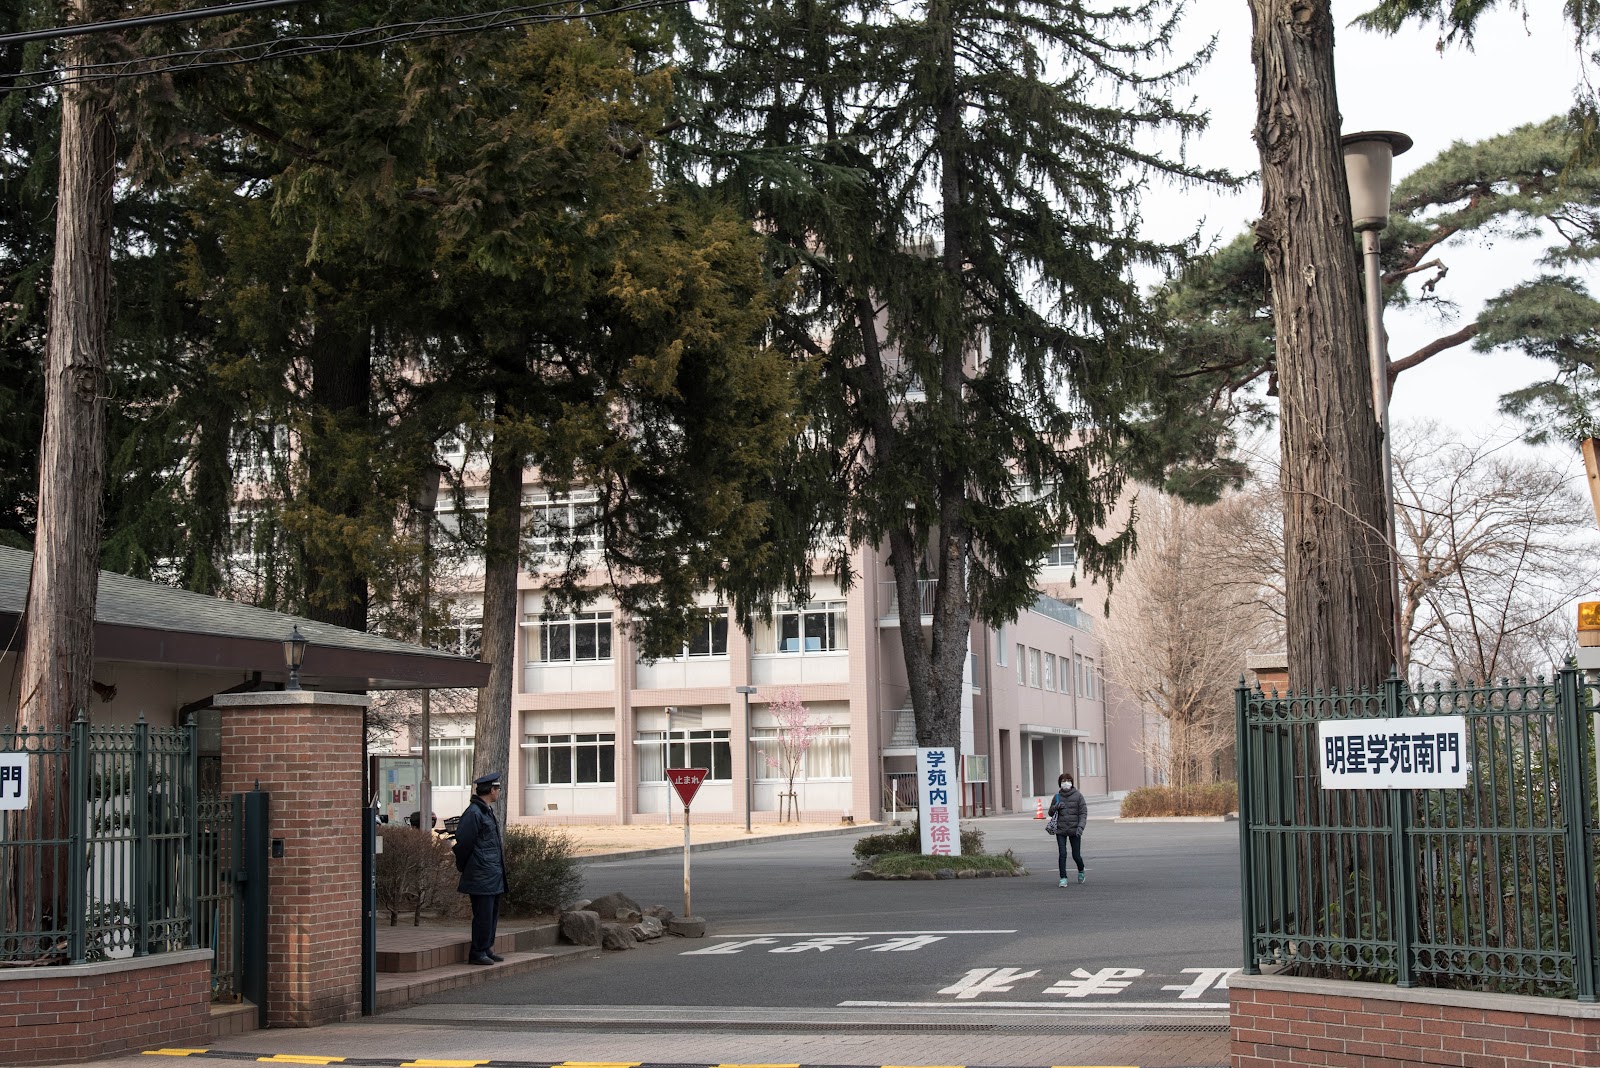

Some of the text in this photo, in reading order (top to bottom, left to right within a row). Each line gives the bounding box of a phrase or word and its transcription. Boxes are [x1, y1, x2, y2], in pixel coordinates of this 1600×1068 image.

[1325, 732, 1460, 774] 明星学苑南門
[0, 766, 22, 798] 門
[675, 775, 700, 785] 止まれ
[678, 935, 948, 956] 止まれ
